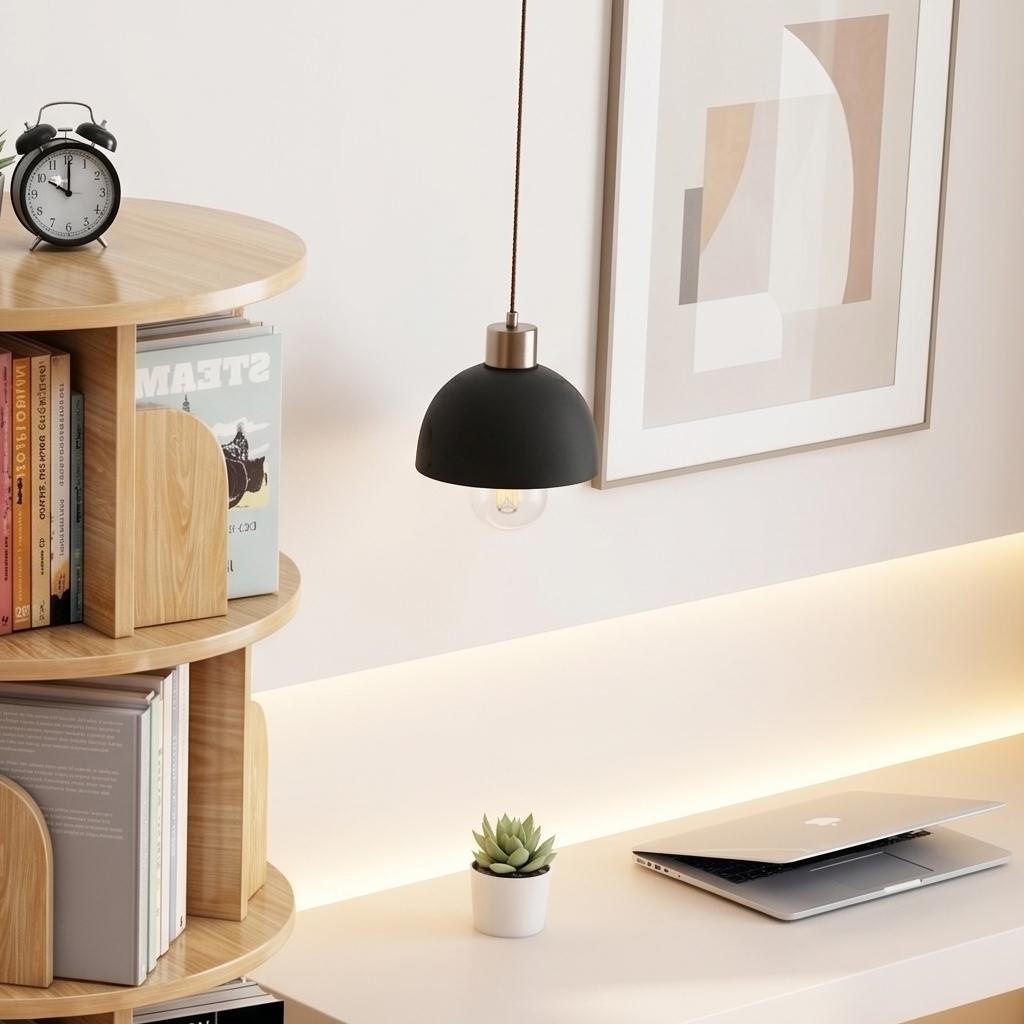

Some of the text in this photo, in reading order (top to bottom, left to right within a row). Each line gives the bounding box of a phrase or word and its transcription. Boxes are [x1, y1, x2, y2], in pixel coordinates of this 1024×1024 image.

[49, 160, 56, 170] 11
[64, 155, 73, 165] 12
[82, 160, 87, 169] 1
[37, 173, 47, 183] 10
[94, 171, 100, 181] 2
[31, 190, 38, 199] 9
[99, 188, 106, 197] 3
[49, 217, 56, 228] 7
[65, 222, 72, 232] 6
